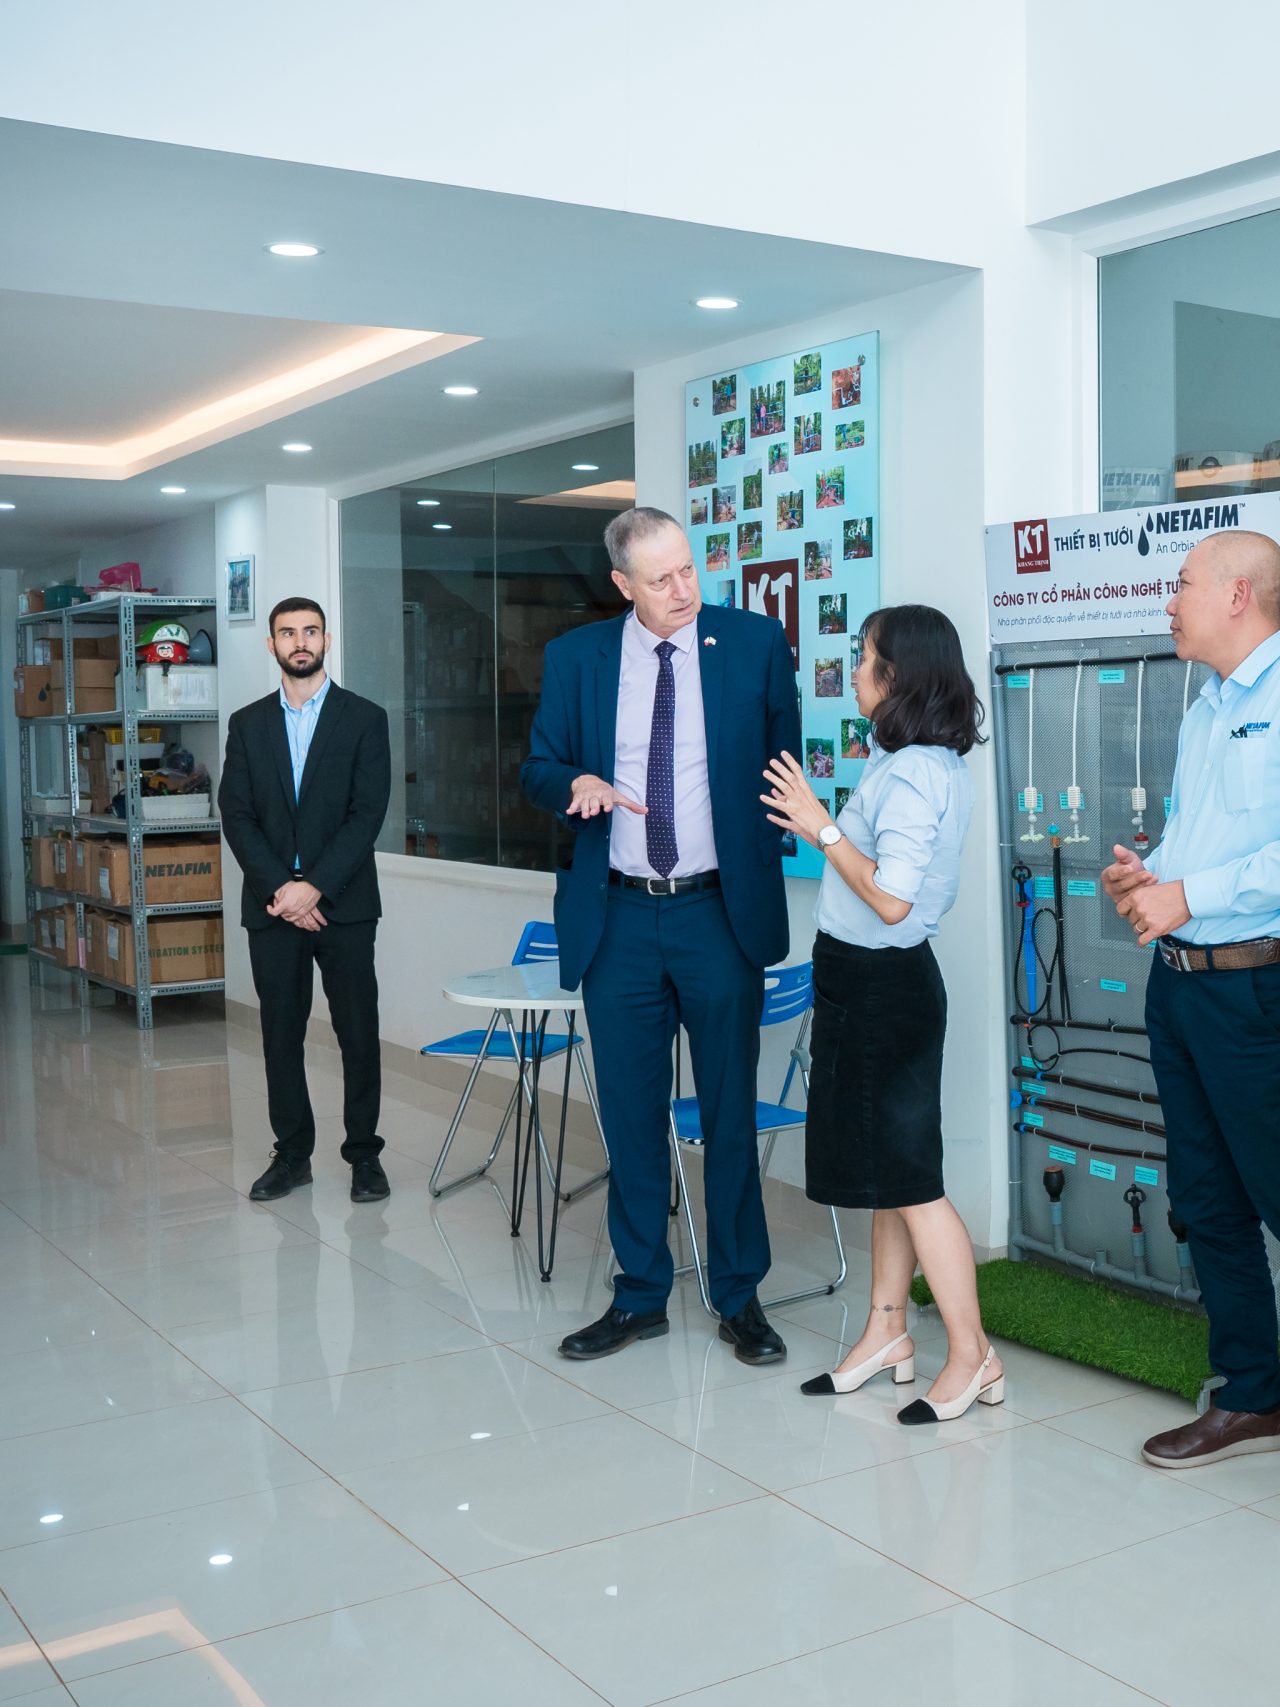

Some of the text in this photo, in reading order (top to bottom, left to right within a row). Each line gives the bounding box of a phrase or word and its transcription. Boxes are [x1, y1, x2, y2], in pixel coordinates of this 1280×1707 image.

[1156, 503, 1239, 534] NETAFIM
[1017, 524, 1045, 559] KT
[1054, 526, 1133, 552] THIẾT BỊ TƯỚI
[1156, 541, 1195, 554] An Orbia
[748, 571, 793, 629] KT
[993, 578, 1180, 608] CÔNG TY CỔ PHẦN CÔNG NGHỆ TƯ
[145, 862, 212, 878] NETAFIM
[192, 943, 224, 955] SYSTE
